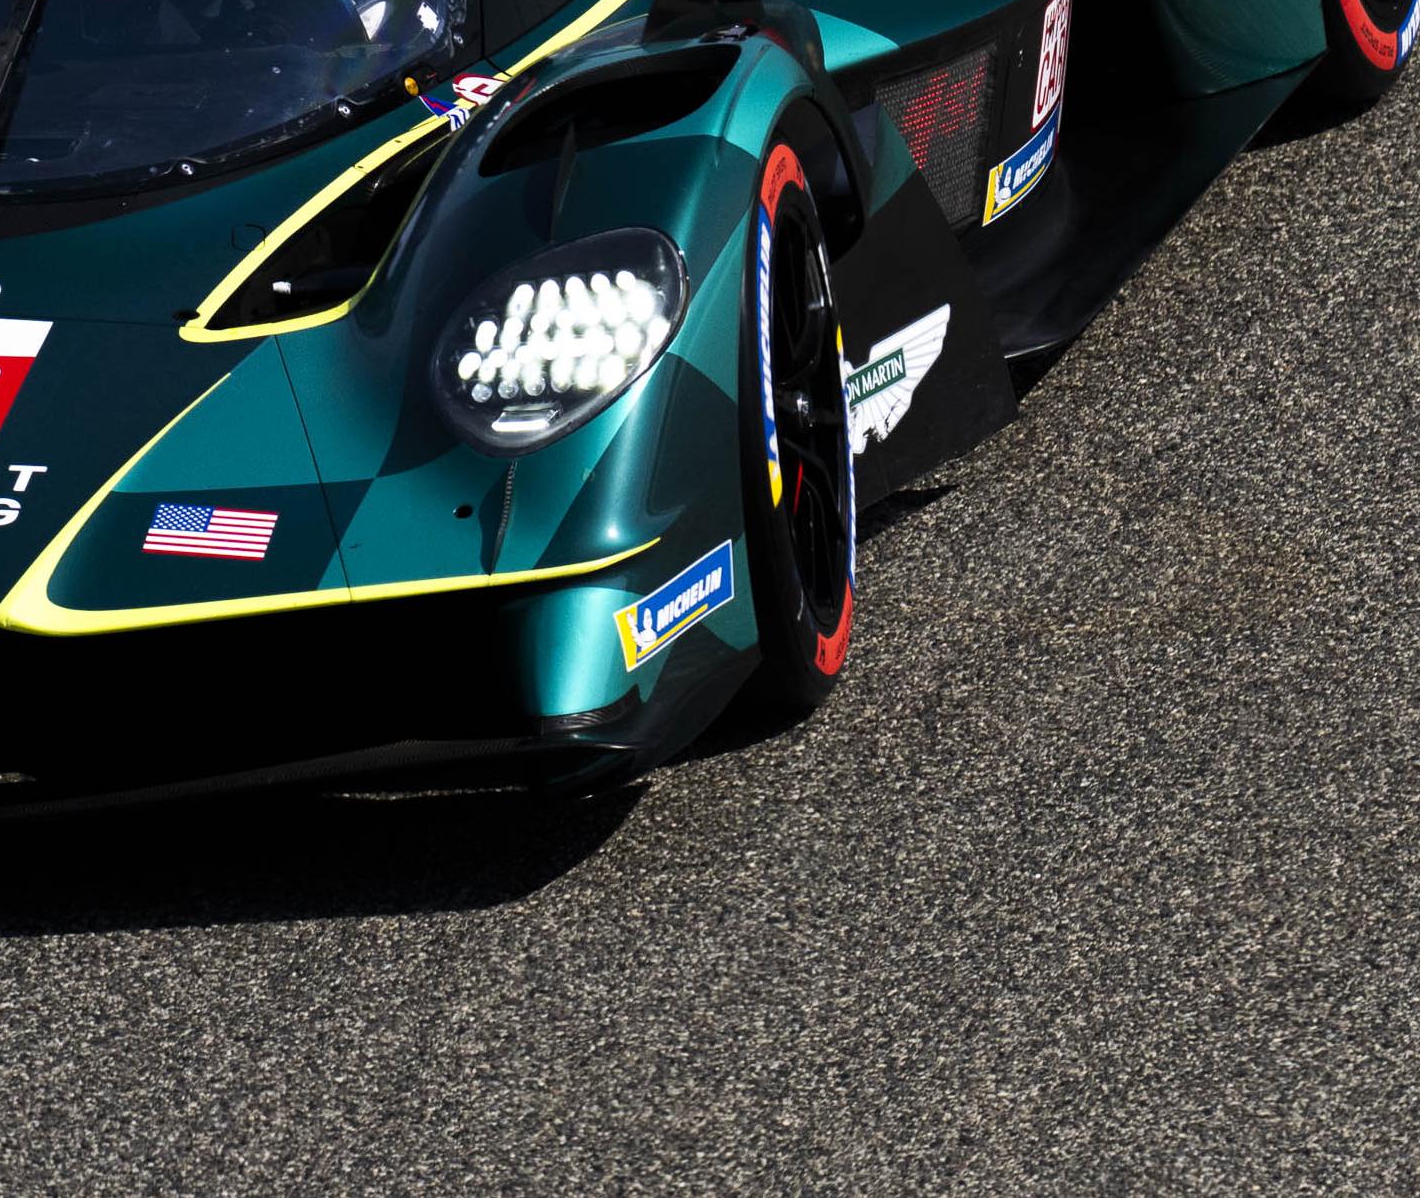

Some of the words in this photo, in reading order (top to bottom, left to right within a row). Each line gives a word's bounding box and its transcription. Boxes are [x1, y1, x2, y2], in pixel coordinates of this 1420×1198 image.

[1037, 26, 1066, 114] CAR
[1012, 128, 1054, 189] MICHELIN
[760, 222, 775, 419] MICHELIN
[861, 354, 904, 394] MARTIN
[656, 566, 723, 632] MICHELIN
